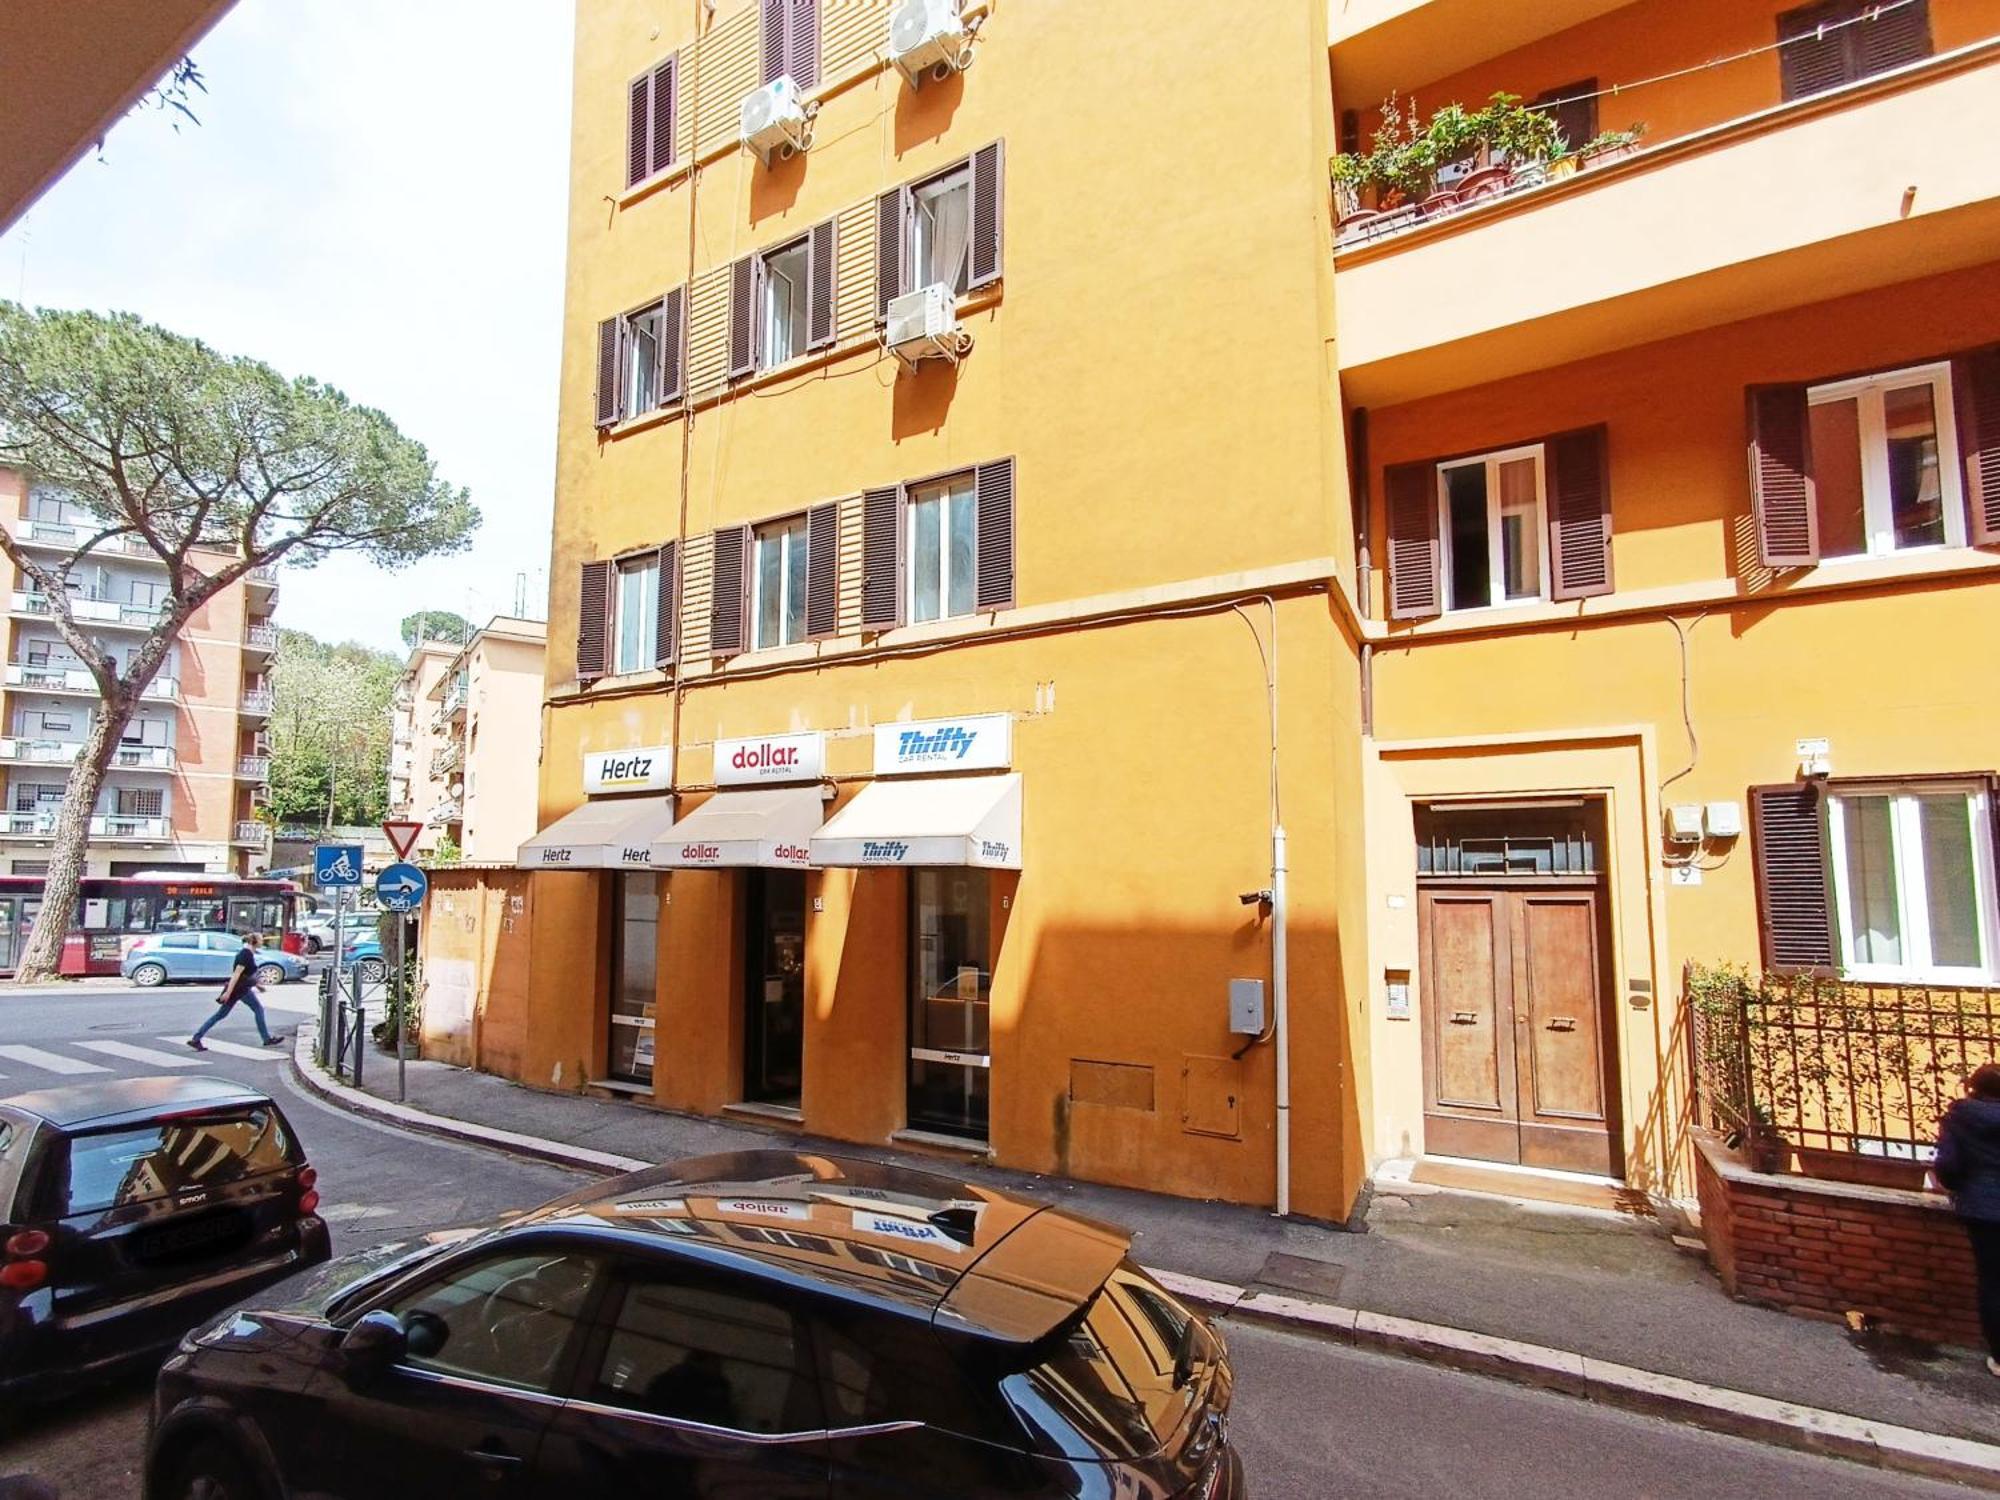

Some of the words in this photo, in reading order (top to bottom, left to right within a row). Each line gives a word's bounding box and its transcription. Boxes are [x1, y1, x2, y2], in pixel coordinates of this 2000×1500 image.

[899, 727, 977, 758] Thrifty
[601, 756, 652, 780] Hertz
[543, 848, 572, 862] Hertz
[622, 848, 651, 863] Hert
[863, 841, 909, 861] Thrifty
[1679, 867, 1692, 882] 9
[180, 1193, 207, 1205] smart
